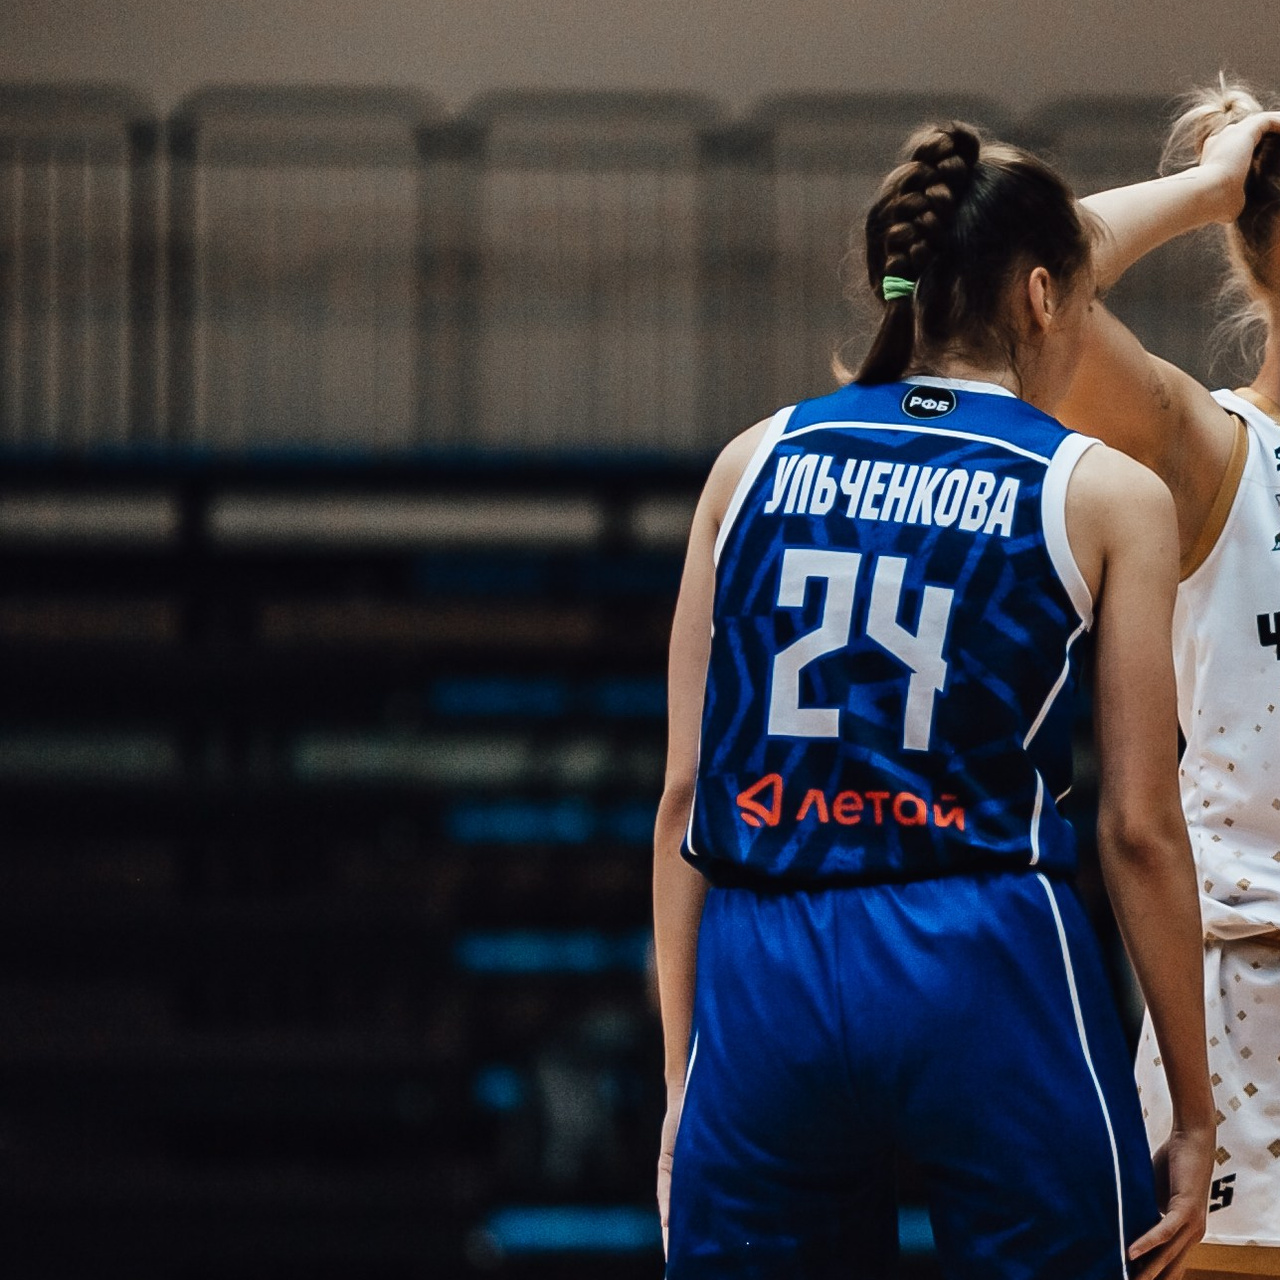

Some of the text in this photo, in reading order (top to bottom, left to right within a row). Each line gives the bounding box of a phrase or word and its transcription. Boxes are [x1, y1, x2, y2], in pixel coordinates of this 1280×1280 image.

[909, 395, 950, 412] РФБ
[763, 453, 1020, 537] УЛЬЧЕНКОВА
[767, 549, 955, 751] 24
[796, 788, 965, 831] летай
